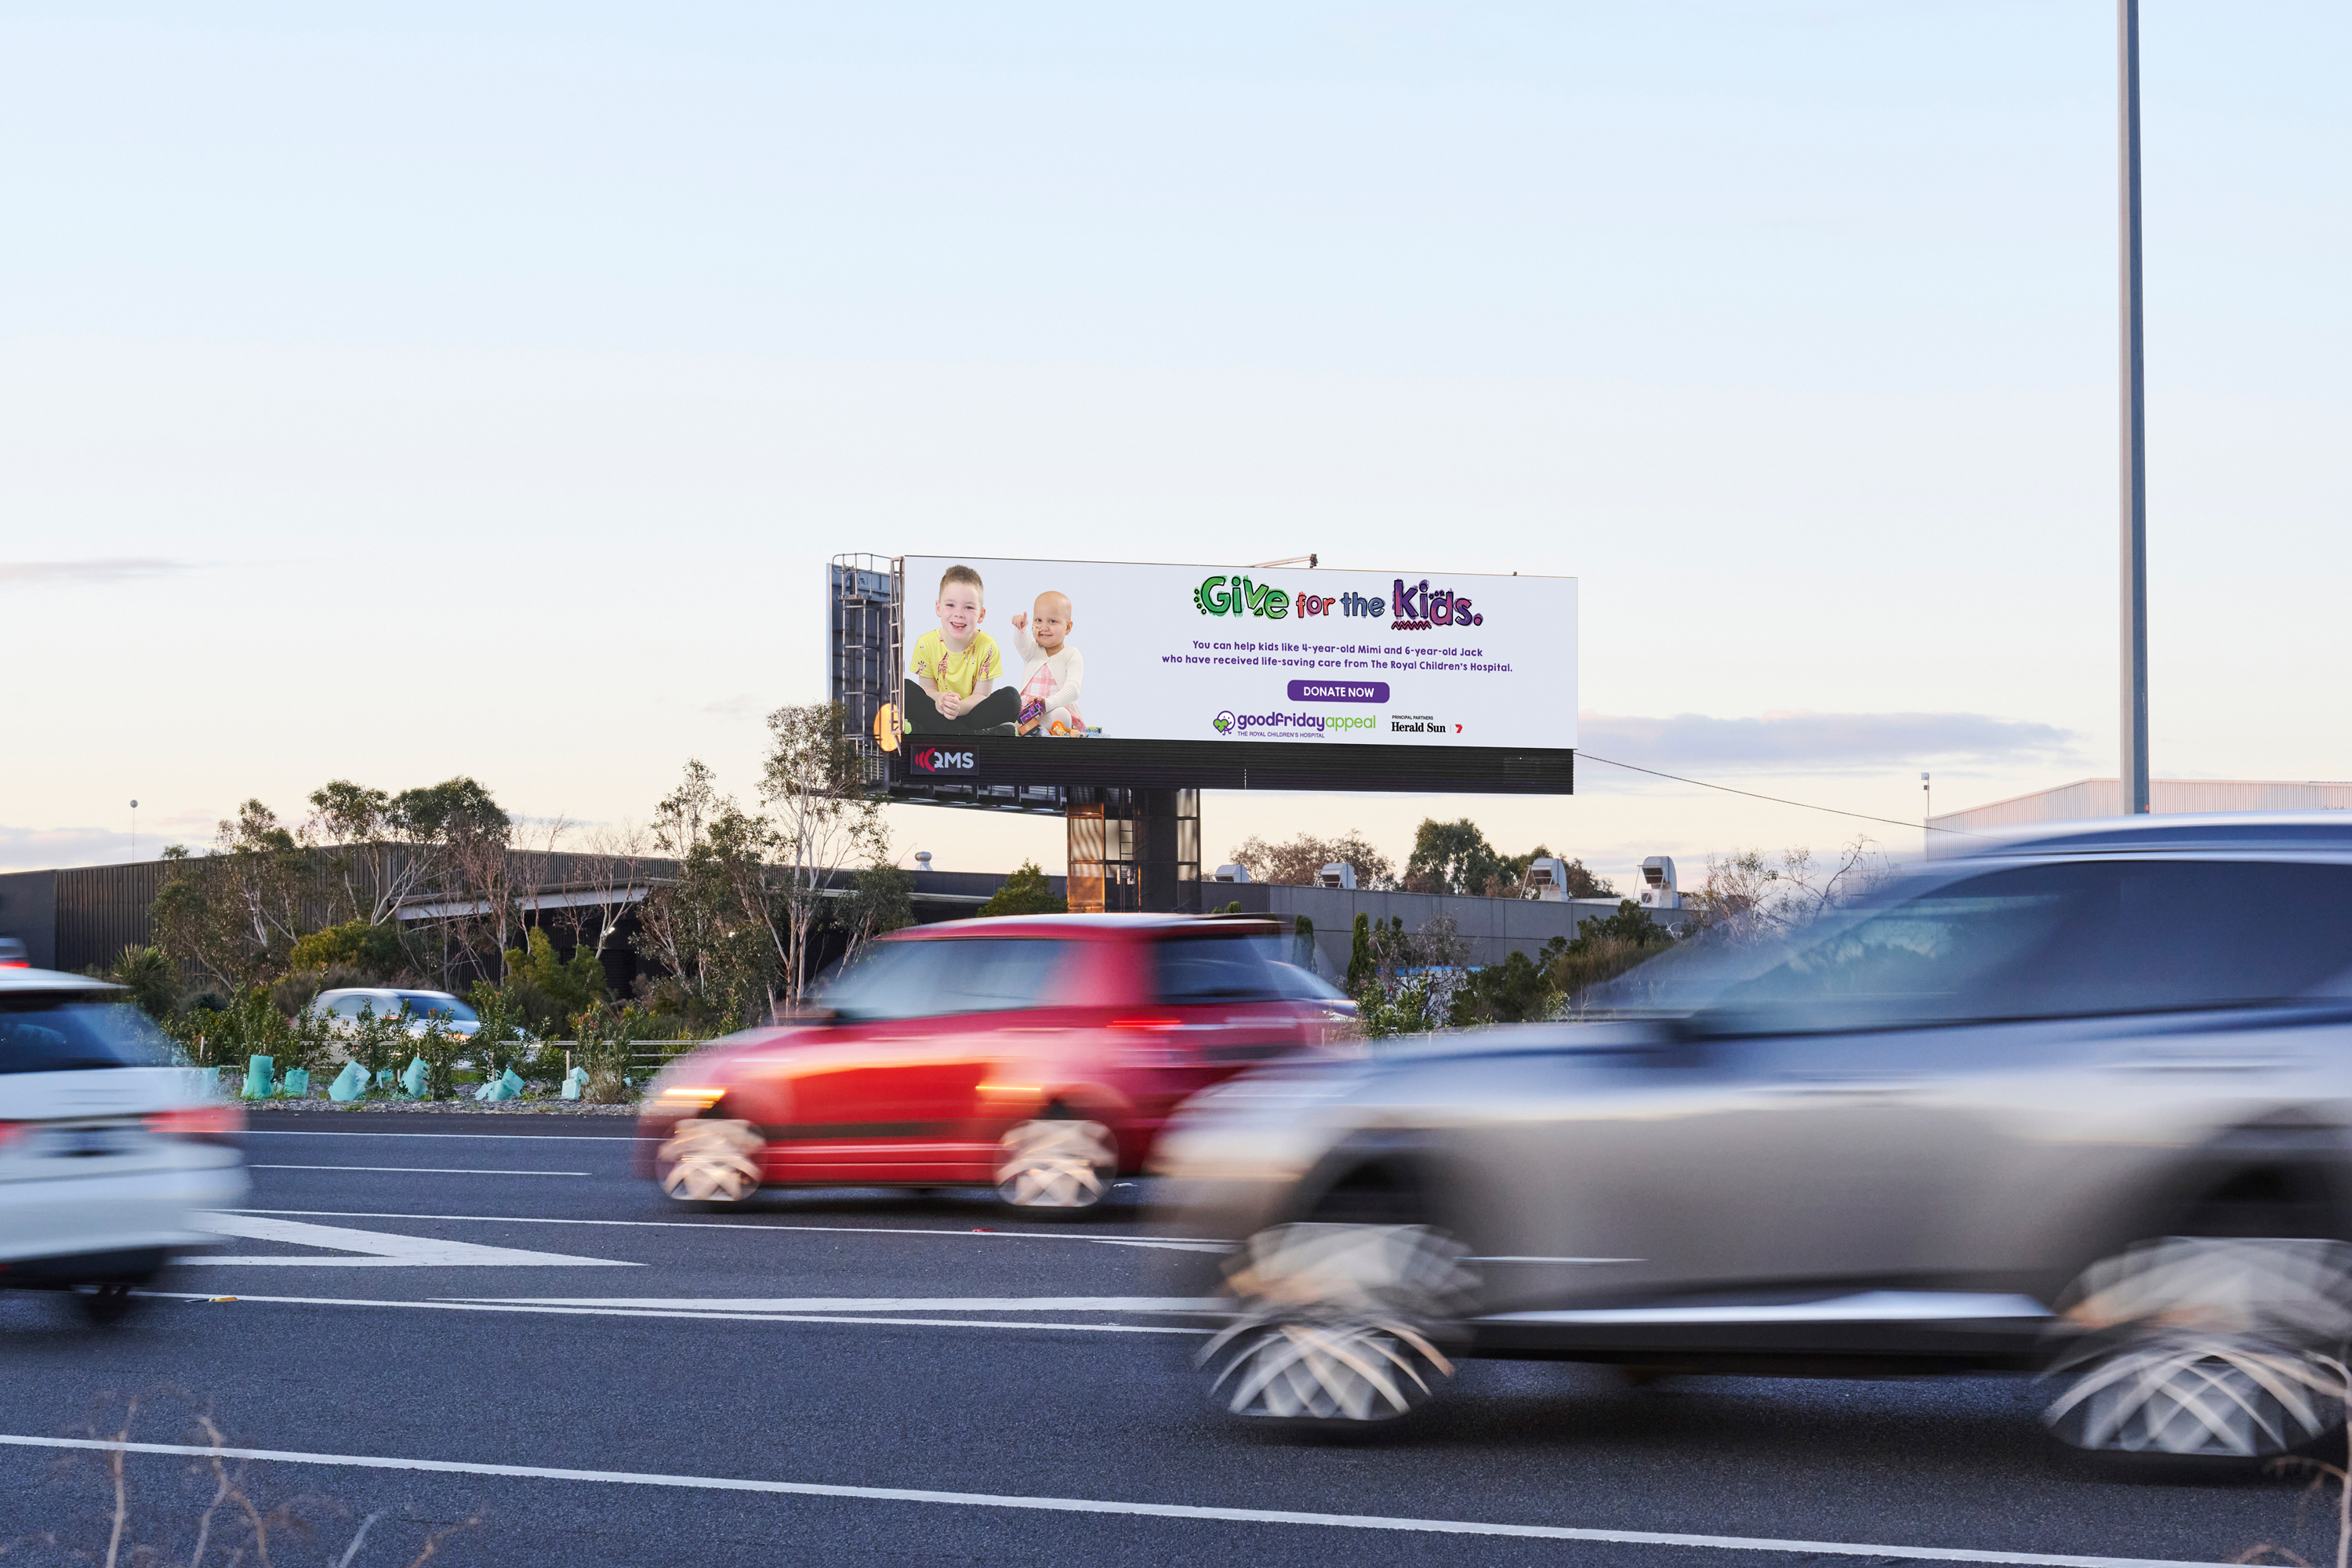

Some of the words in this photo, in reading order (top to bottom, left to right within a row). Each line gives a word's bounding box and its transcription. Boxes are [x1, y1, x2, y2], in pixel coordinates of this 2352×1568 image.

[1200, 575, 1290, 619] Give
[1296, 592, 1336, 619] for
[1340, 591, 1385, 618] the
[1192, 640, 1210, 649] You
[1234, 641, 1256, 652] help
[1258, 642, 1279, 652] kids
[1281, 643, 1300, 652] like
[1301, 643, 1356, 654] 4-year-old
[1358, 645, 1381, 654] Mimi
[1384, 646, 1403, 655] and
[1404, 646, 1457, 657] 6-year-old
[1460, 648, 1483, 657] Jack
[1162, 654, 1183, 663] who
[1185, 655, 1210, 664] have
[1214, 655, 1259, 666] received
[1261, 656, 1316, 669] life-saving
[1344, 659, 1368, 668] from
[1370, 659, 1388, 669] The
[1391, 660, 1417, 672] Royal
[1419, 661, 1468, 671] Children's
[1470, 662, 1513, 673] Hospital.
[1303, 686, 1346, 697] DONATE
[1348, 688, 1374, 698] NOW
[1391, 721, 1425, 732] Herald
[1427, 722, 1446, 733] Sun
[924, 748, 975, 772] QMS
